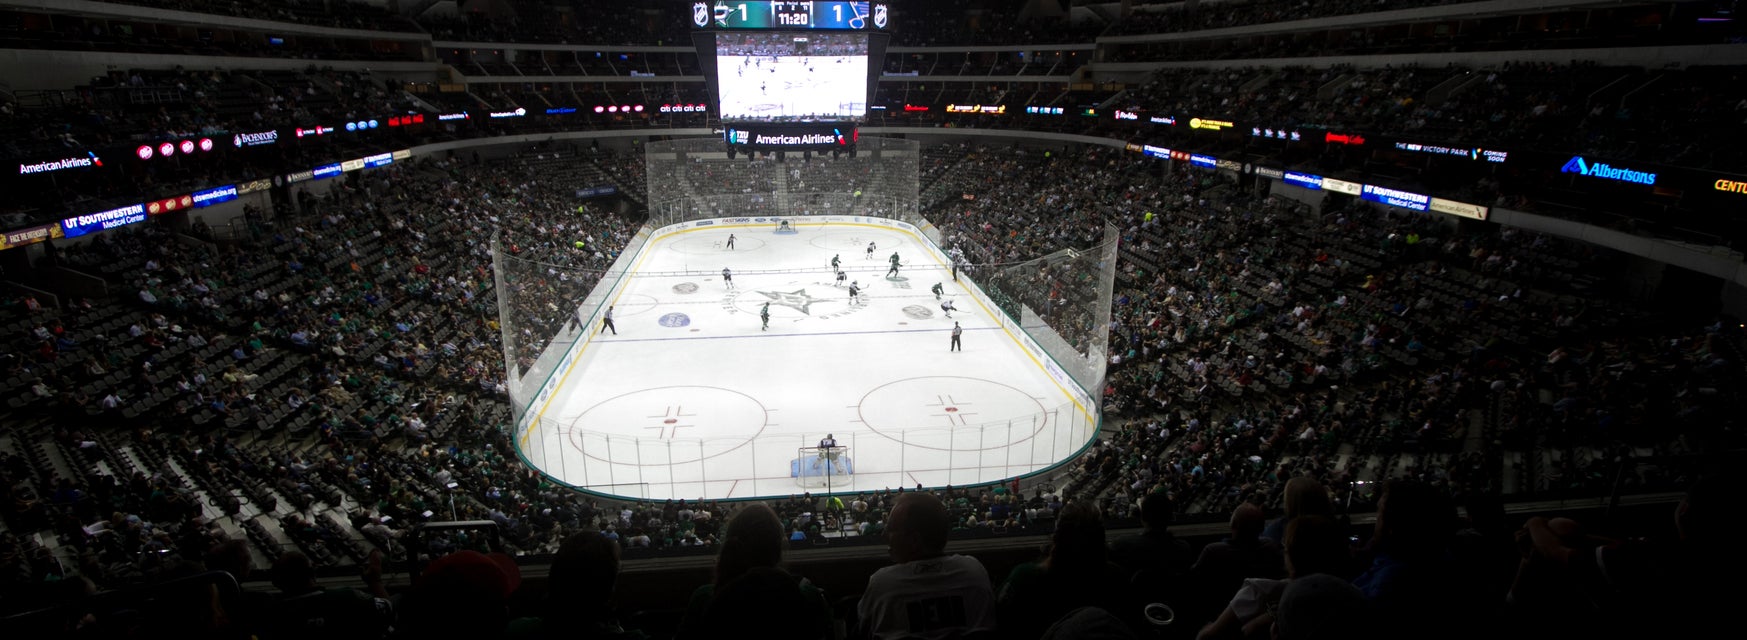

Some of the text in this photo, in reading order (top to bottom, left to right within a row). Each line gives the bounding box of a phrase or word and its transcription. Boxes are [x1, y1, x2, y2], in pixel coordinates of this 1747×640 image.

[738, 4, 747, 21] 1
[778, 13, 808, 25] 11:20
[833, 5, 842, 21] 1
[736, 130, 749, 139] TXU
[756, 133, 835, 144] American Airlines
[1407, 143, 1423, 151] NEW
[1423, 146, 1450, 154] VICTORY
[1450, 148, 1468, 156] PARK
[1483, 150, 1507, 158] COMING
[20, 158, 91, 174] American Airlines
[1588, 162, 1656, 185] Albertsons
[1364, 184, 1373, 193] UT
[1373, 186, 1428, 204] SOUTHWESTERN
[1714, 179, 1747, 194] CENTU
[1388, 198, 1426, 211] Medical Center
[65, 218, 78, 229] UT
[78, 204, 144, 226] SOUTHWESTERN
[103, 214, 145, 229] Medical Center
